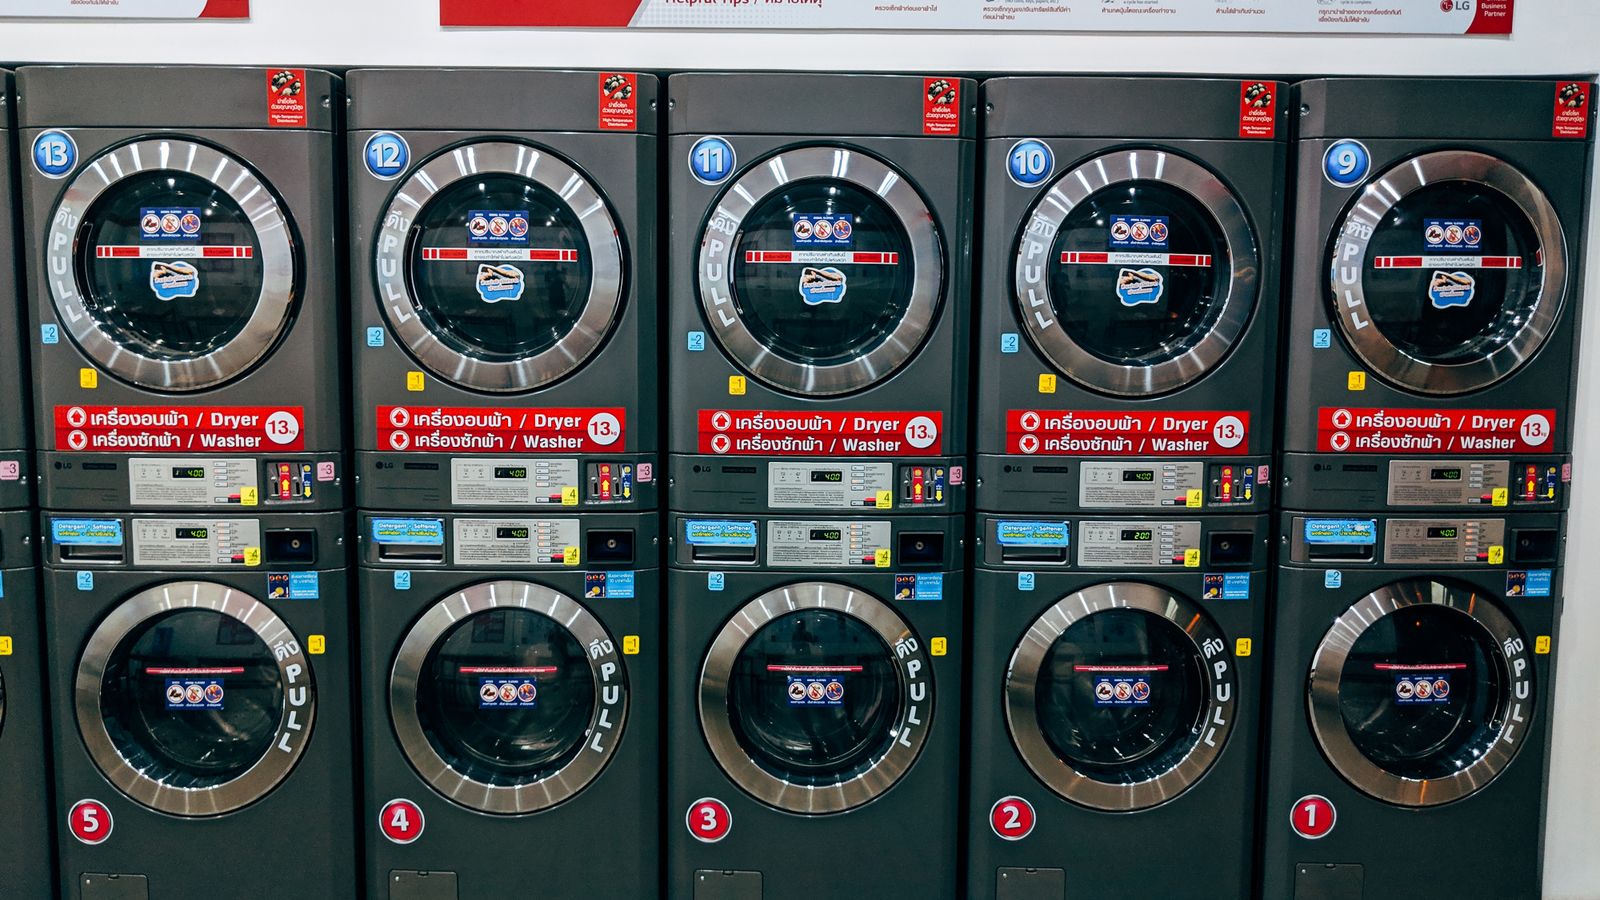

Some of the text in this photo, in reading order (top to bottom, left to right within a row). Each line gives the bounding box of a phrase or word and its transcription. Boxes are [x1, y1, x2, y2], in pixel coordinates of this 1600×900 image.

[1455, 1, 1470, 10] LG
[40, 141, 68, 166] 13
[371, 143, 400, 167] 12
[698, 148, 723, 172] 11
[1015, 150, 1045, 174] 10
[1339, 151, 1356, 174] 9
[55, 208, 77, 229] ดึง
[386, 211, 409, 232] ดึง
[53, 232, 81, 322] PULL
[382, 235, 411, 323] PULL
[707, 239, 735, 327] PULL
[1025, 242, 1053, 329] PULL
[1341, 243, 1368, 330] PULL
[49, 327, 55, 337] 2
[376, 330, 380, 340] 2
[1322, 332, 1327, 341] 2
[696, 335, 701, 344] 2
[1010, 337, 1015, 346] 2
[416, 375, 419, 384] 1
[739, 379, 741, 388] 1
[1048, 377, 1051, 386] 1
[1358, 375, 1360, 383] 1
[91, 408, 188, 427] เครื่องอบผ้า
[211, 413, 259, 428] Dryer
[413, 409, 511, 428] เครื่องอบผ้า
[534, 414, 581, 429] Dryer
[735, 413, 831, 431] เครื่องอบผ้า
[854, 417, 900, 433] Dryer
[1045, 413, 1141, 431] เครื่องอบผ้า
[1163, 417, 1208, 433] Dryer
[1356, 411, 1450, 429] เครื่องอบผ้า
[1472, 415, 1515, 431] Dryer
[268, 420, 288, 434] 13
[590, 421, 610, 436] 13
[908, 425, 927, 439] 13
[1216, 425, 1234, 438] 13
[1523, 423, 1540, 437] 13
[92, 429, 180, 447] เครื่องซักผ้า
[202, 434, 261, 447] Washer
[415, 430, 503, 448] เครื่องซักผ้า
[523, 435, 583, 448] Washer
[736, 434, 823, 451] เครื่องซักผ้า
[844, 439, 901, 451] Washer
[1045, 434, 1132, 451] เครื่องซักผ้า
[1152, 438, 1209, 451] Washer
[1356, 431, 1441, 448] เครื่องซักผ้า
[1461, 436, 1515, 449] Washer
[10, 463, 16, 473] 3
[326, 465, 332, 474] 3
[645, 466, 650, 475] 3
[956, 469, 961, 479] 3
[1264, 468, 1267, 478] 3
[249, 489, 255, 498] 4
[570, 489, 575, 498] 4
[884, 493, 889, 502] 4
[1194, 492, 1199, 500] 4
[1500, 491, 1505, 499] 4
[252, 549, 257, 558] 4
[572, 548, 577, 558] 4
[883, 551, 888, 560] 4
[1192, 551, 1197, 560] 4
[85, 573, 91, 582] 2
[403, 572, 408, 582] 2
[716, 574, 722, 583] 2
[1027, 574, 1032, 583] 2
[1334, 572, 1339, 581] 2
[319, 639, 321, 647] 1
[590, 639, 614, 660] ดึง
[634, 639, 636, 647] 1
[896, 638, 918, 659] ดึง
[941, 640, 943, 648] 1
[1203, 638, 1223, 658] ดึง
[1246, 641, 1248, 649] 1
[1504, 637, 1524, 658] ดึง
[1545, 639, 1547, 647] 1
[274, 640, 300, 661] ดึง
[591, 662, 619, 753] PULL
[899, 660, 925, 748] PULL
[1204, 658, 1230, 747] PULL
[1504, 658, 1529, 744] PULL
[278, 664, 306, 753] PULL
[84, 809, 98, 832] 5
[391, 809, 409, 831] 4
[701, 808, 716, 830] 3
[1003, 806, 1020, 828] 2
[1305, 804, 1315, 826] 1
